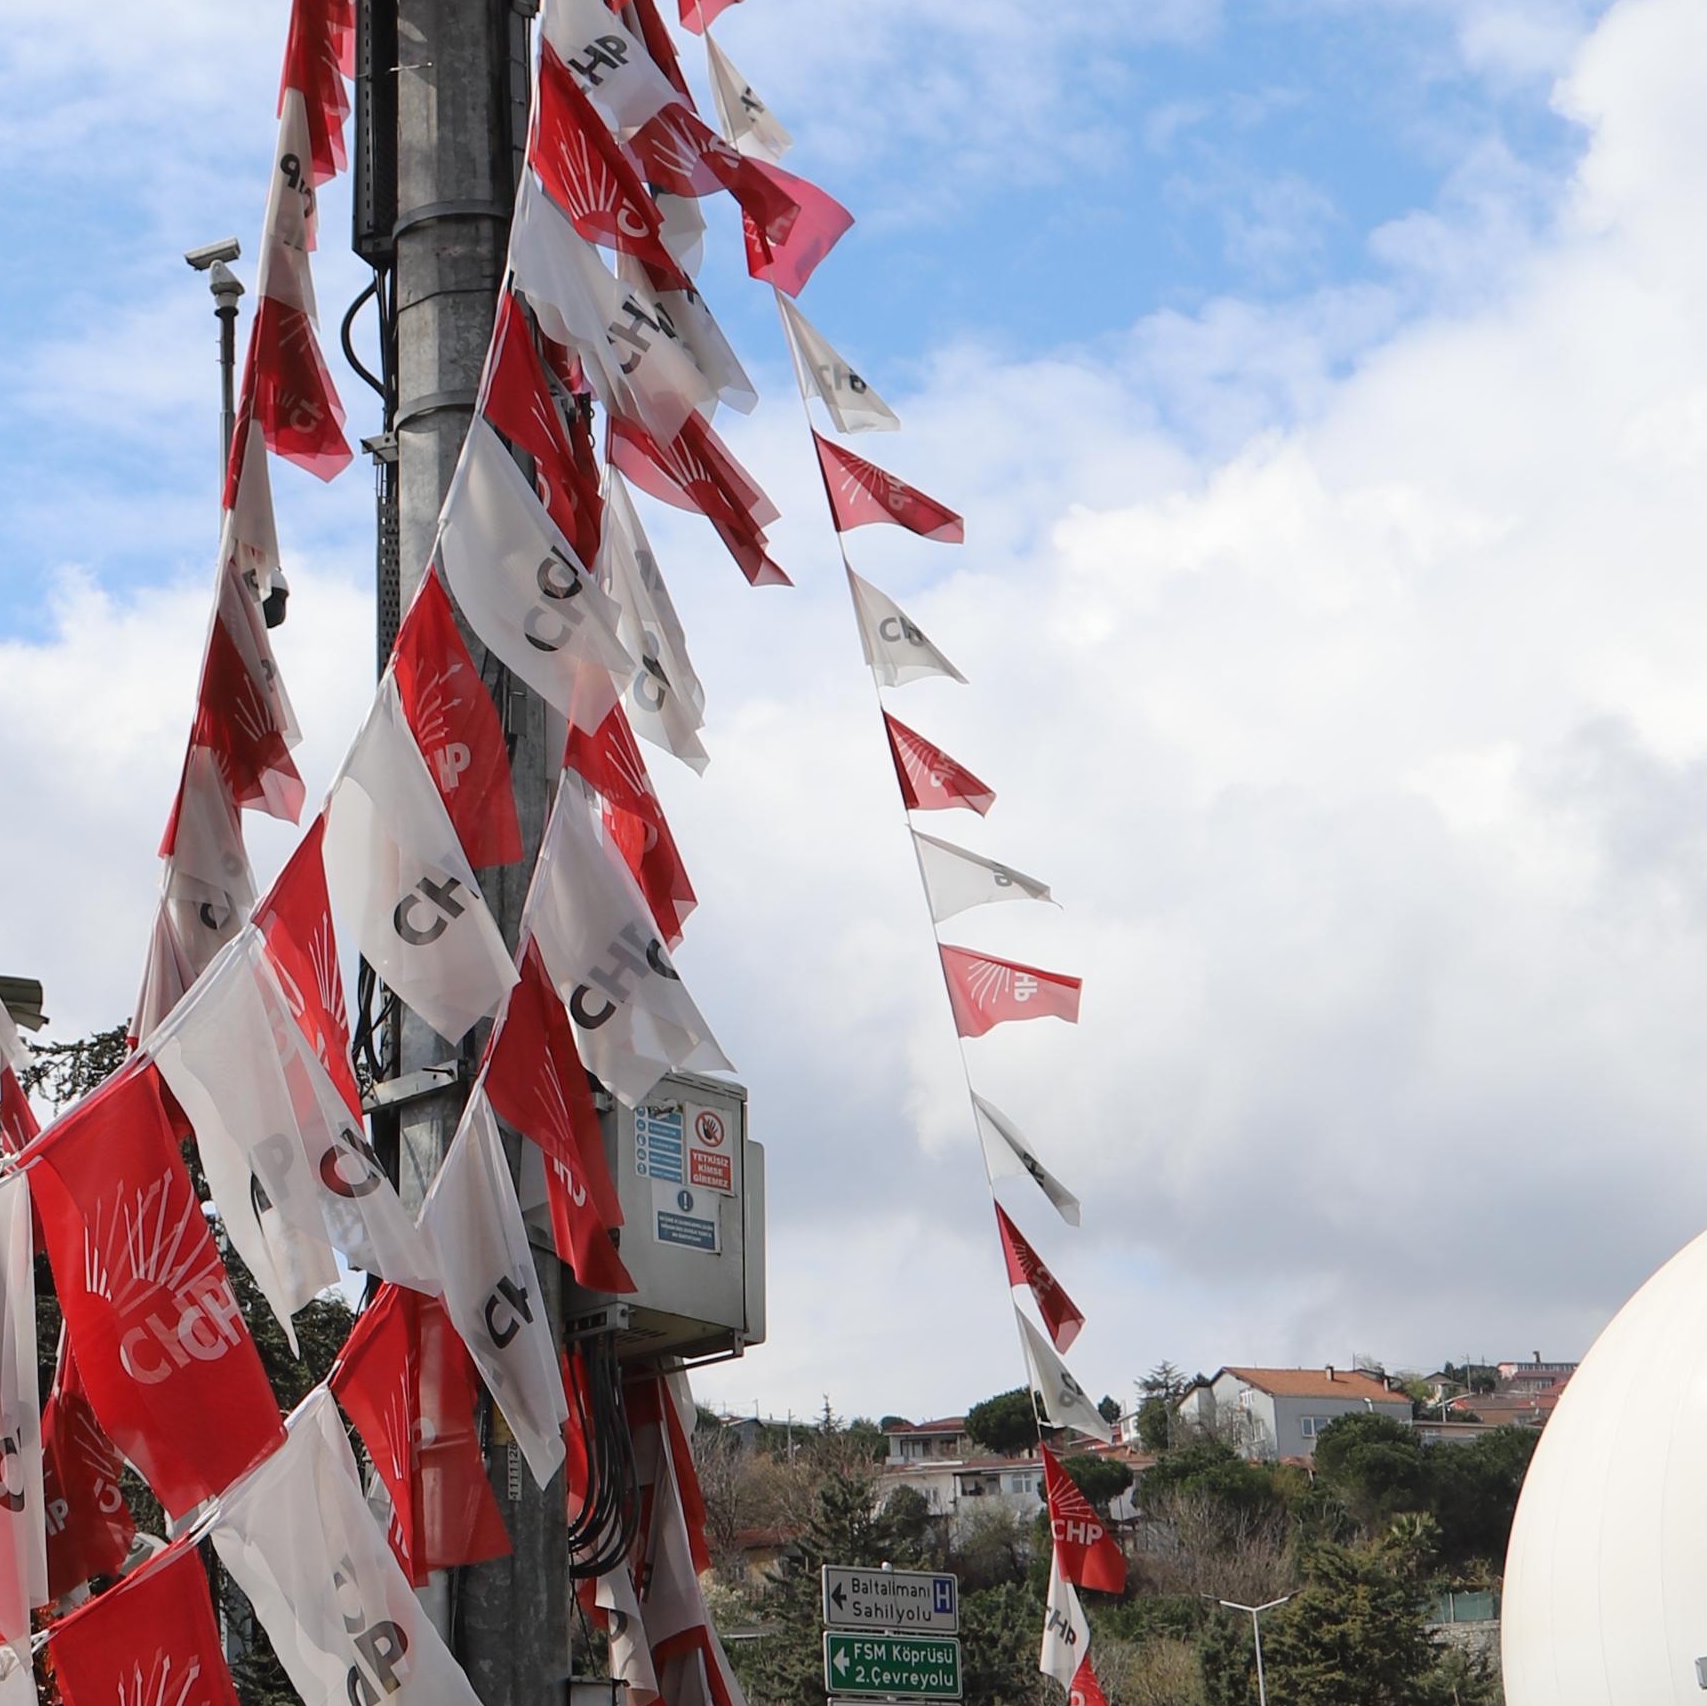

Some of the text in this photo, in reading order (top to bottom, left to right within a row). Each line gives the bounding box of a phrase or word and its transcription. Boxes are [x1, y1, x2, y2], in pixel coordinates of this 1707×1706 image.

[426, 742, 470, 792] HP
[393, 876, 470, 946] CH
[693, 1152, 729, 1167] YETKİSİZ
[698, 1164, 723, 1177] KİMSE
[693, 1174, 729, 1188] GİREMEZ
[485, 1276, 533, 1350] CH
[1052, 1518, 1103, 1545] CHP
[852, 1578, 930, 1598] Baltalimanı
[853, 1643, 953, 1667] FSM Köprüsü
